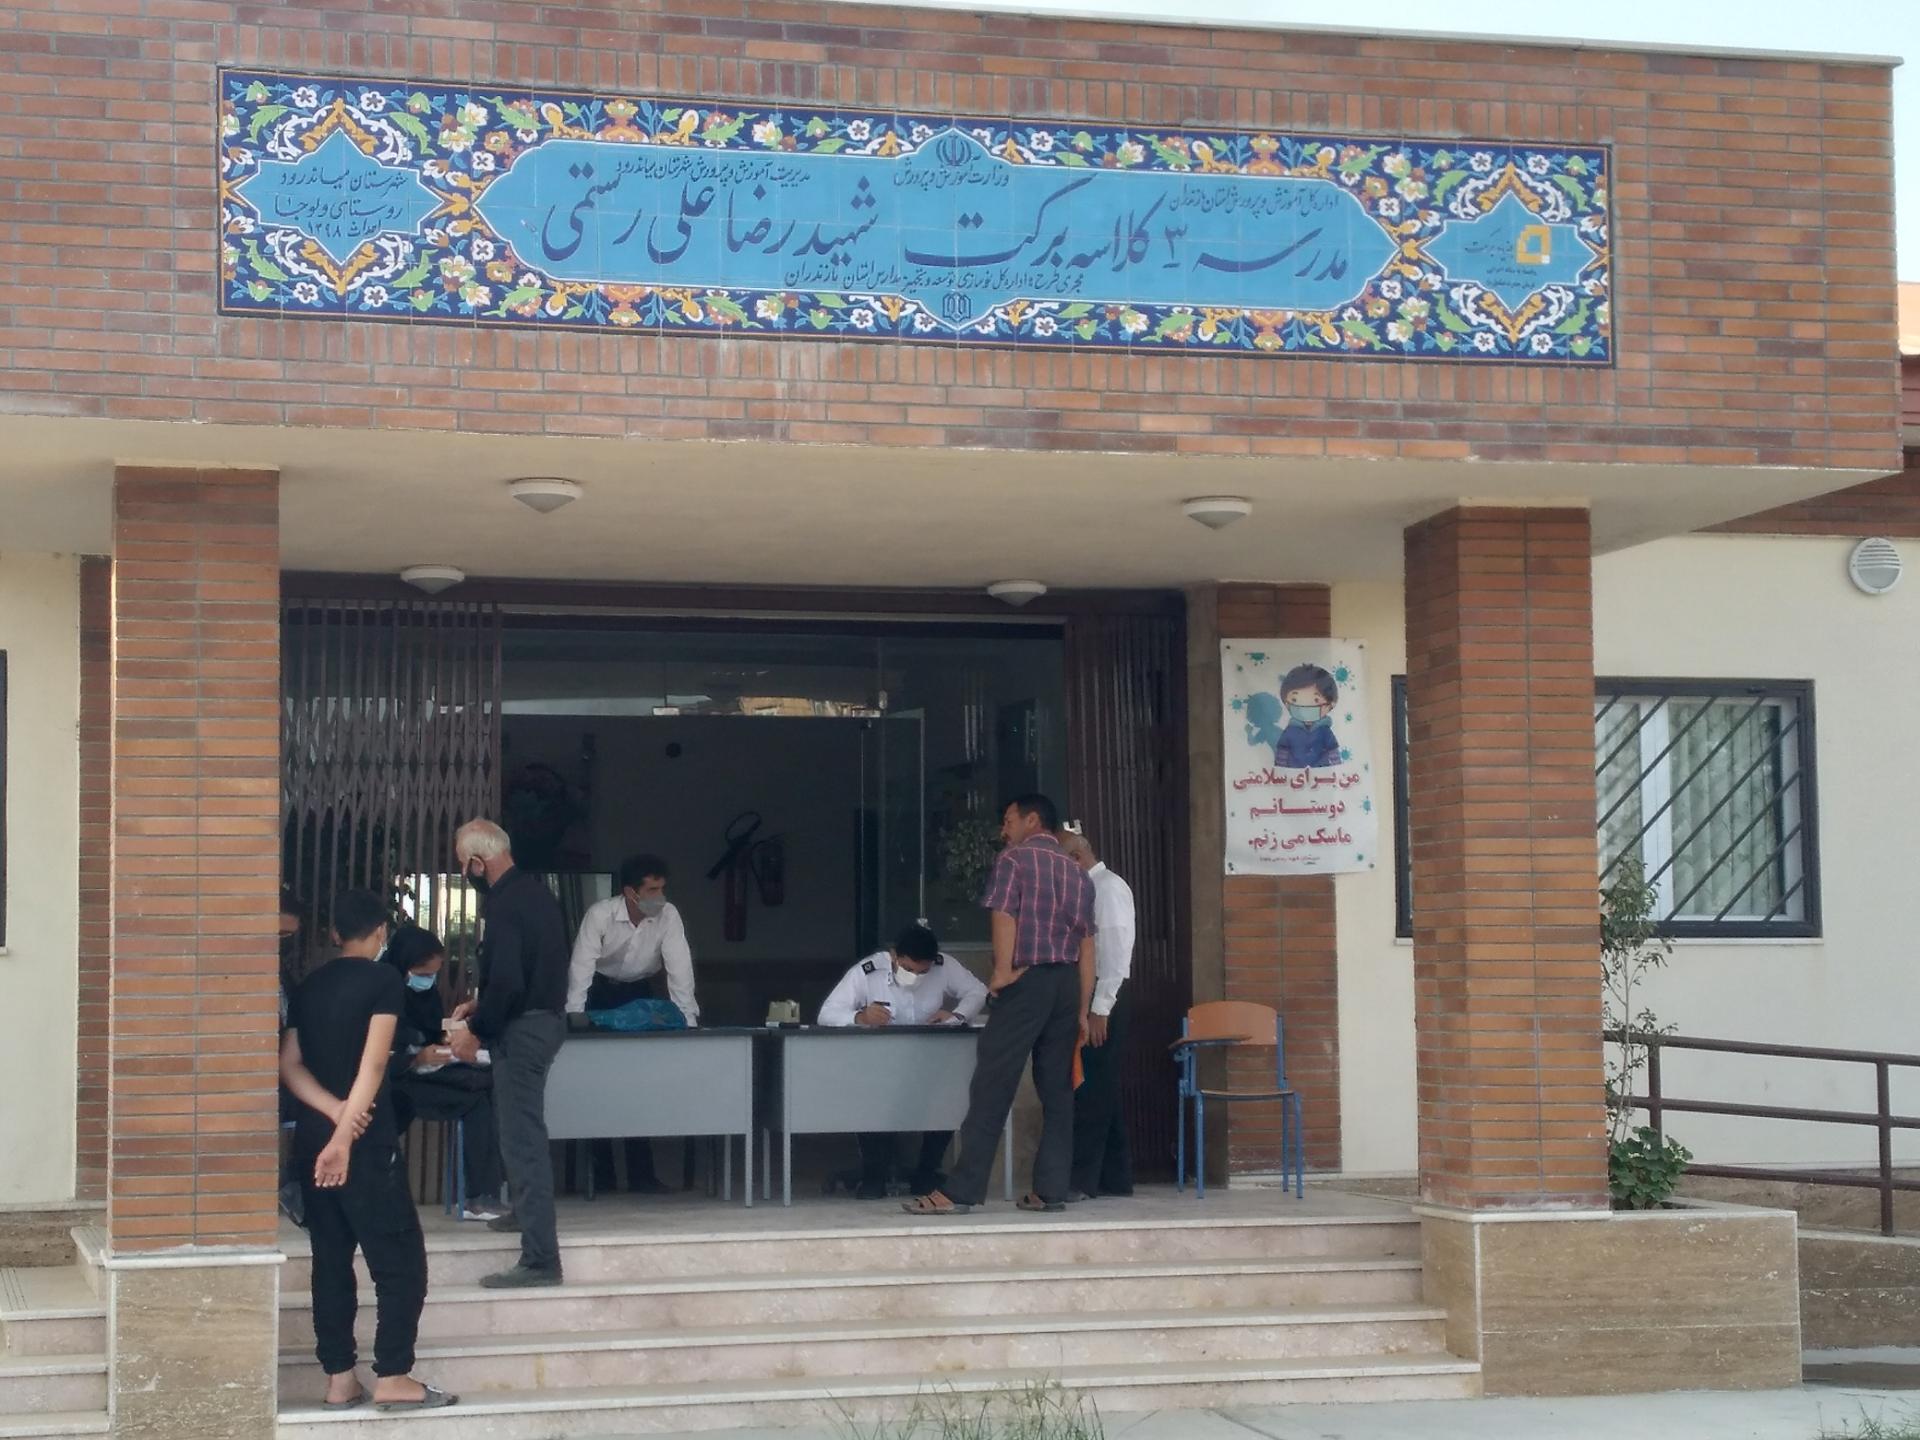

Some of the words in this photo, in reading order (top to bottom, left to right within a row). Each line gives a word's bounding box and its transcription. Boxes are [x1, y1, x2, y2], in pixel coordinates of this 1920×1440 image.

[281, 167, 350, 190] میاندرود
[654, 154, 693, 180] شهرستان
[691, 155, 729, 187] پرورش
[734, 159, 773, 184] آموزش
[770, 166, 810, 188] مدیریت
[893, 156, 930, 192] پرورش
[967, 163, 1010, 187] وزارت
[350, 170, 408, 198] شهرستان
[541, 161, 643, 262] رستمی
[647, 181, 716, 265] علی
[726, 184, 796, 254] رضا
[792, 175, 879, 267] شهید
[904, 172, 1098, 267] برکت
[347, 218, 382, 238] احداث
[1192, 227, 1348, 281] مدرسه
[1233, 767, 1288, 790] سلامتی
[1290, 767, 1337, 790] برای
[1339, 771, 1361, 788] من
[1249, 798, 1346, 819] دوستانم
[1281, 833, 1305, 850] می
[1308, 827, 1353, 845] ماسک
